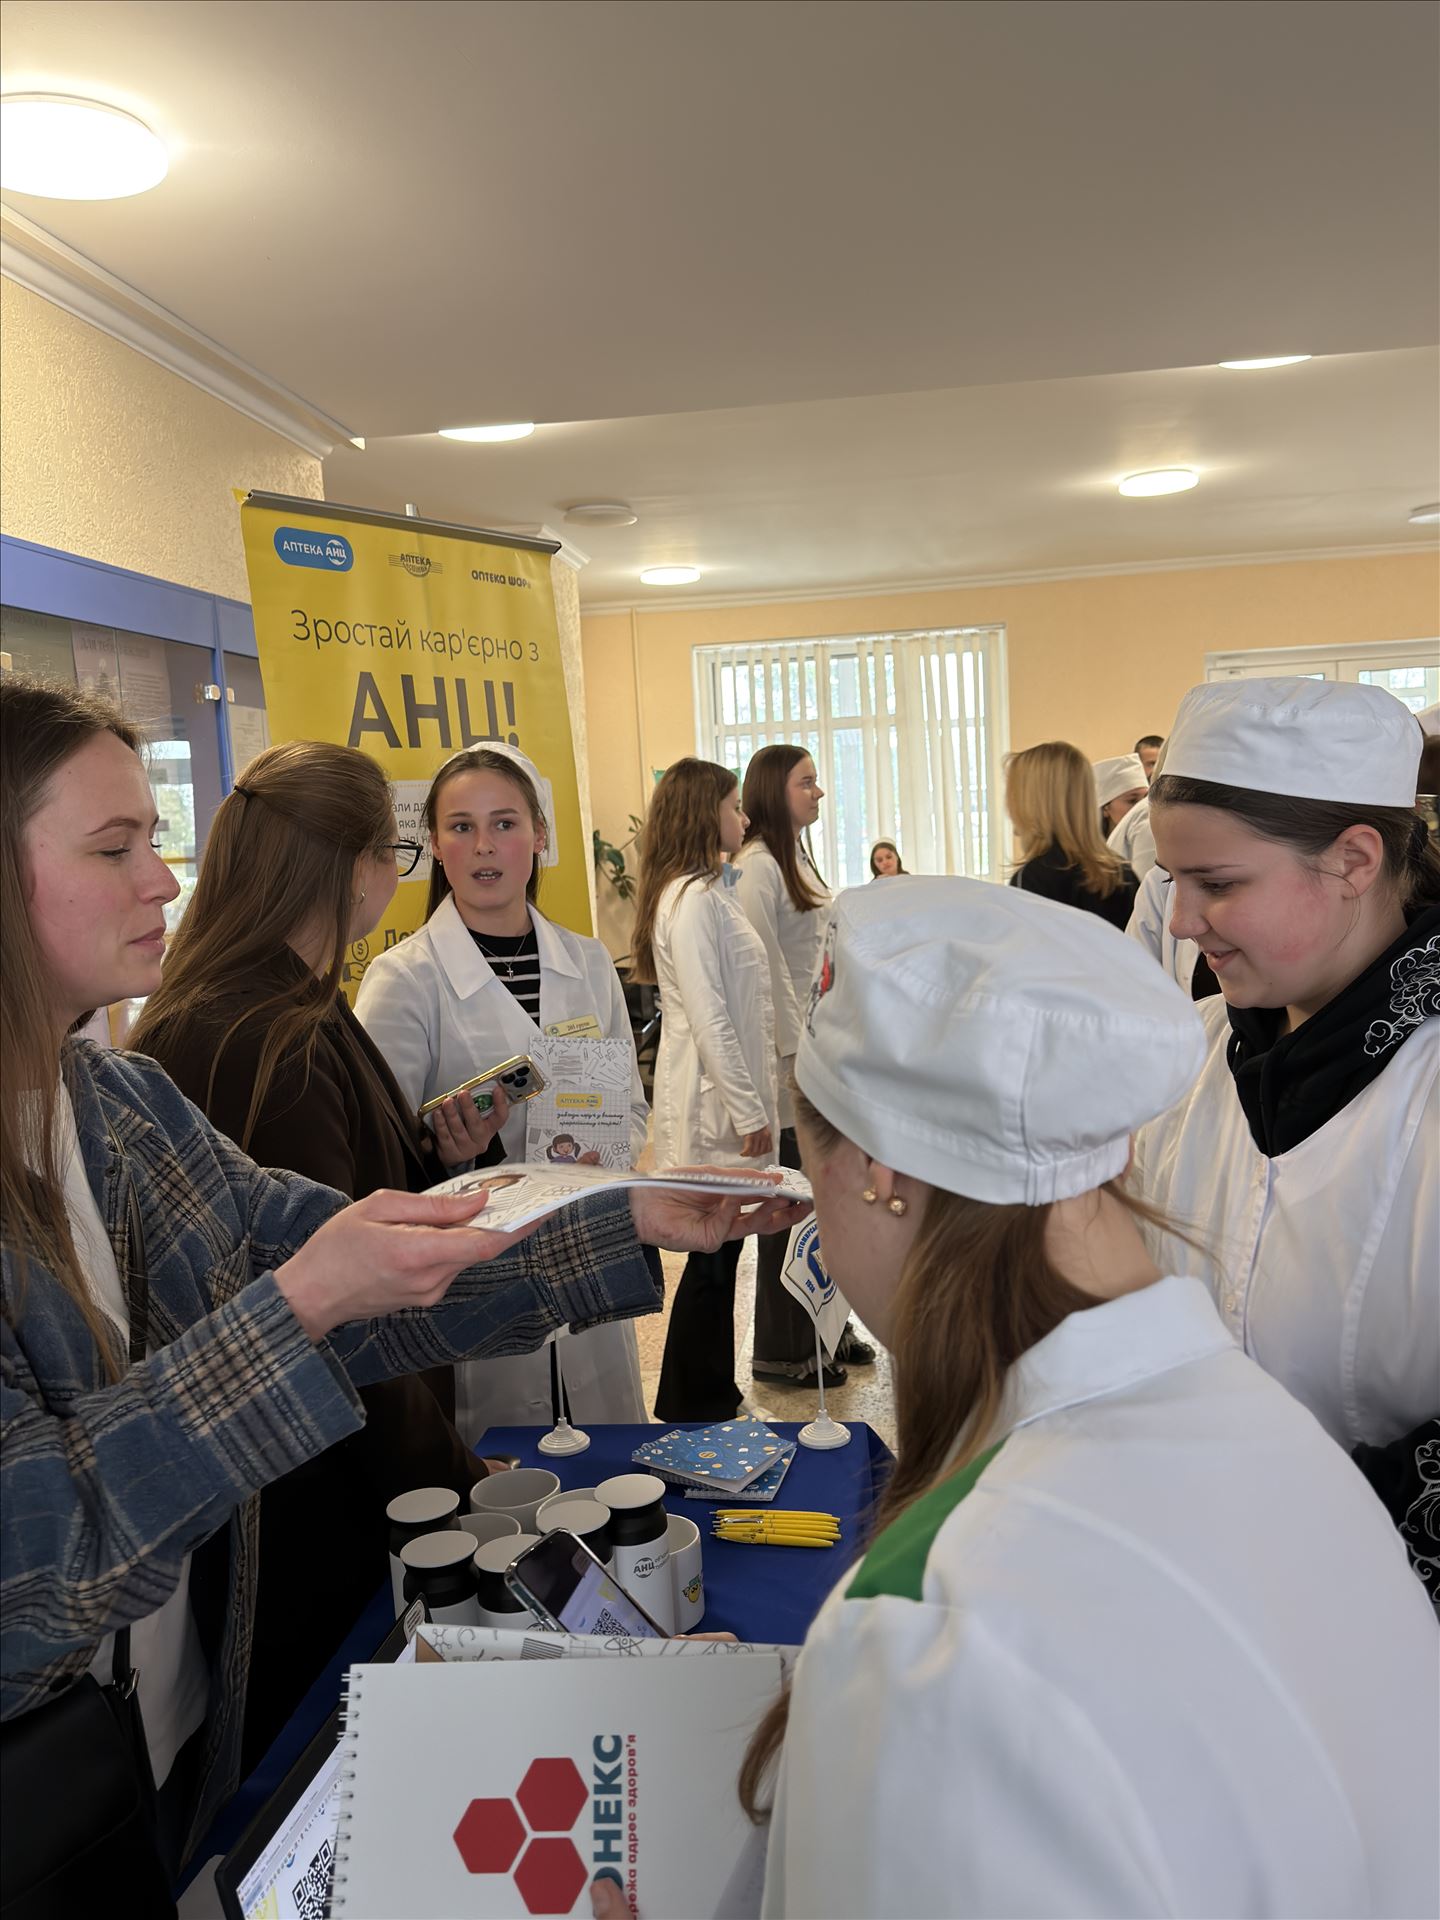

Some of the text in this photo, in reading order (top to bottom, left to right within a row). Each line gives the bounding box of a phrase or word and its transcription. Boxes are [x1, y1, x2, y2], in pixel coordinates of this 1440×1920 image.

[283, 540, 347, 560] АПТЕКА АНЦ
[400, 553, 431, 565] АПТЕКА
[290, 609, 540, 664] Зростай кар'єрно з
[347, 671, 520, 750] АНЦ!
[633, 1561, 655, 1574] АНЦ
[626, 1734, 639, 1920] режа адрес здоров'я
